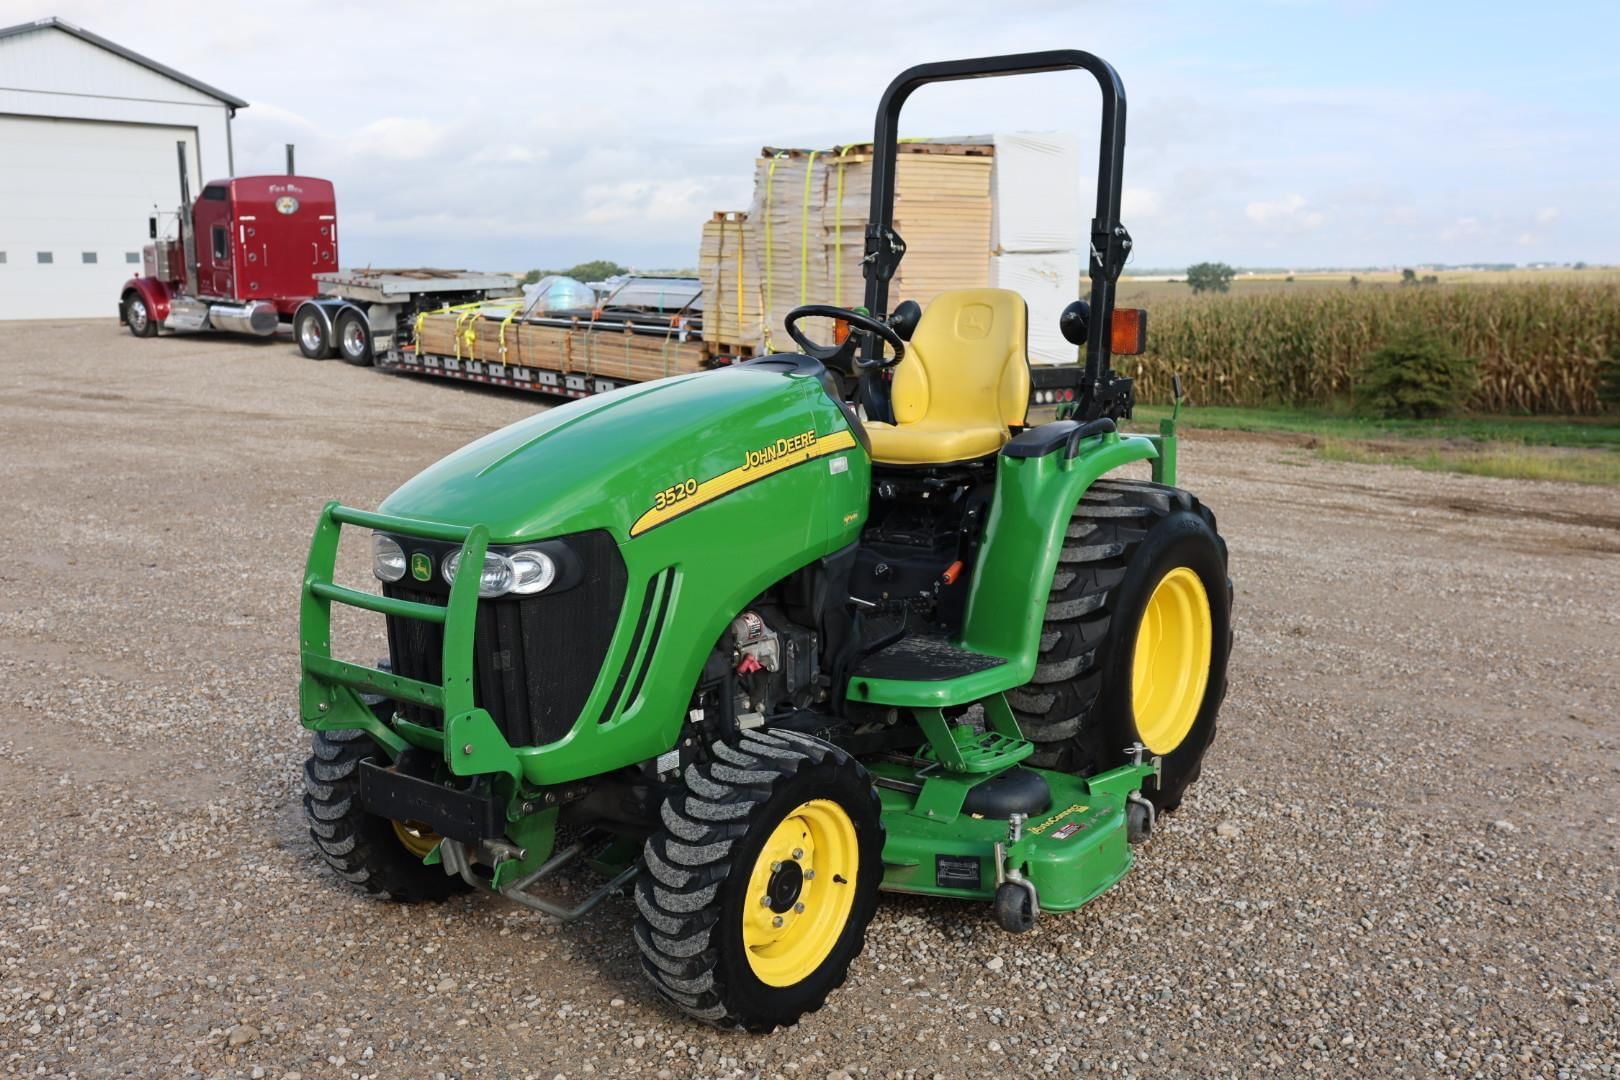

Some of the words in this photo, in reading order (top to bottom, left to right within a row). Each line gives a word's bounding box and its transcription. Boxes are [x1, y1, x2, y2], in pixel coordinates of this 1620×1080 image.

[742, 445, 776, 471] JOHN
[776, 430, 816, 457] DEERE
[655, 478, 697, 510] 3520
